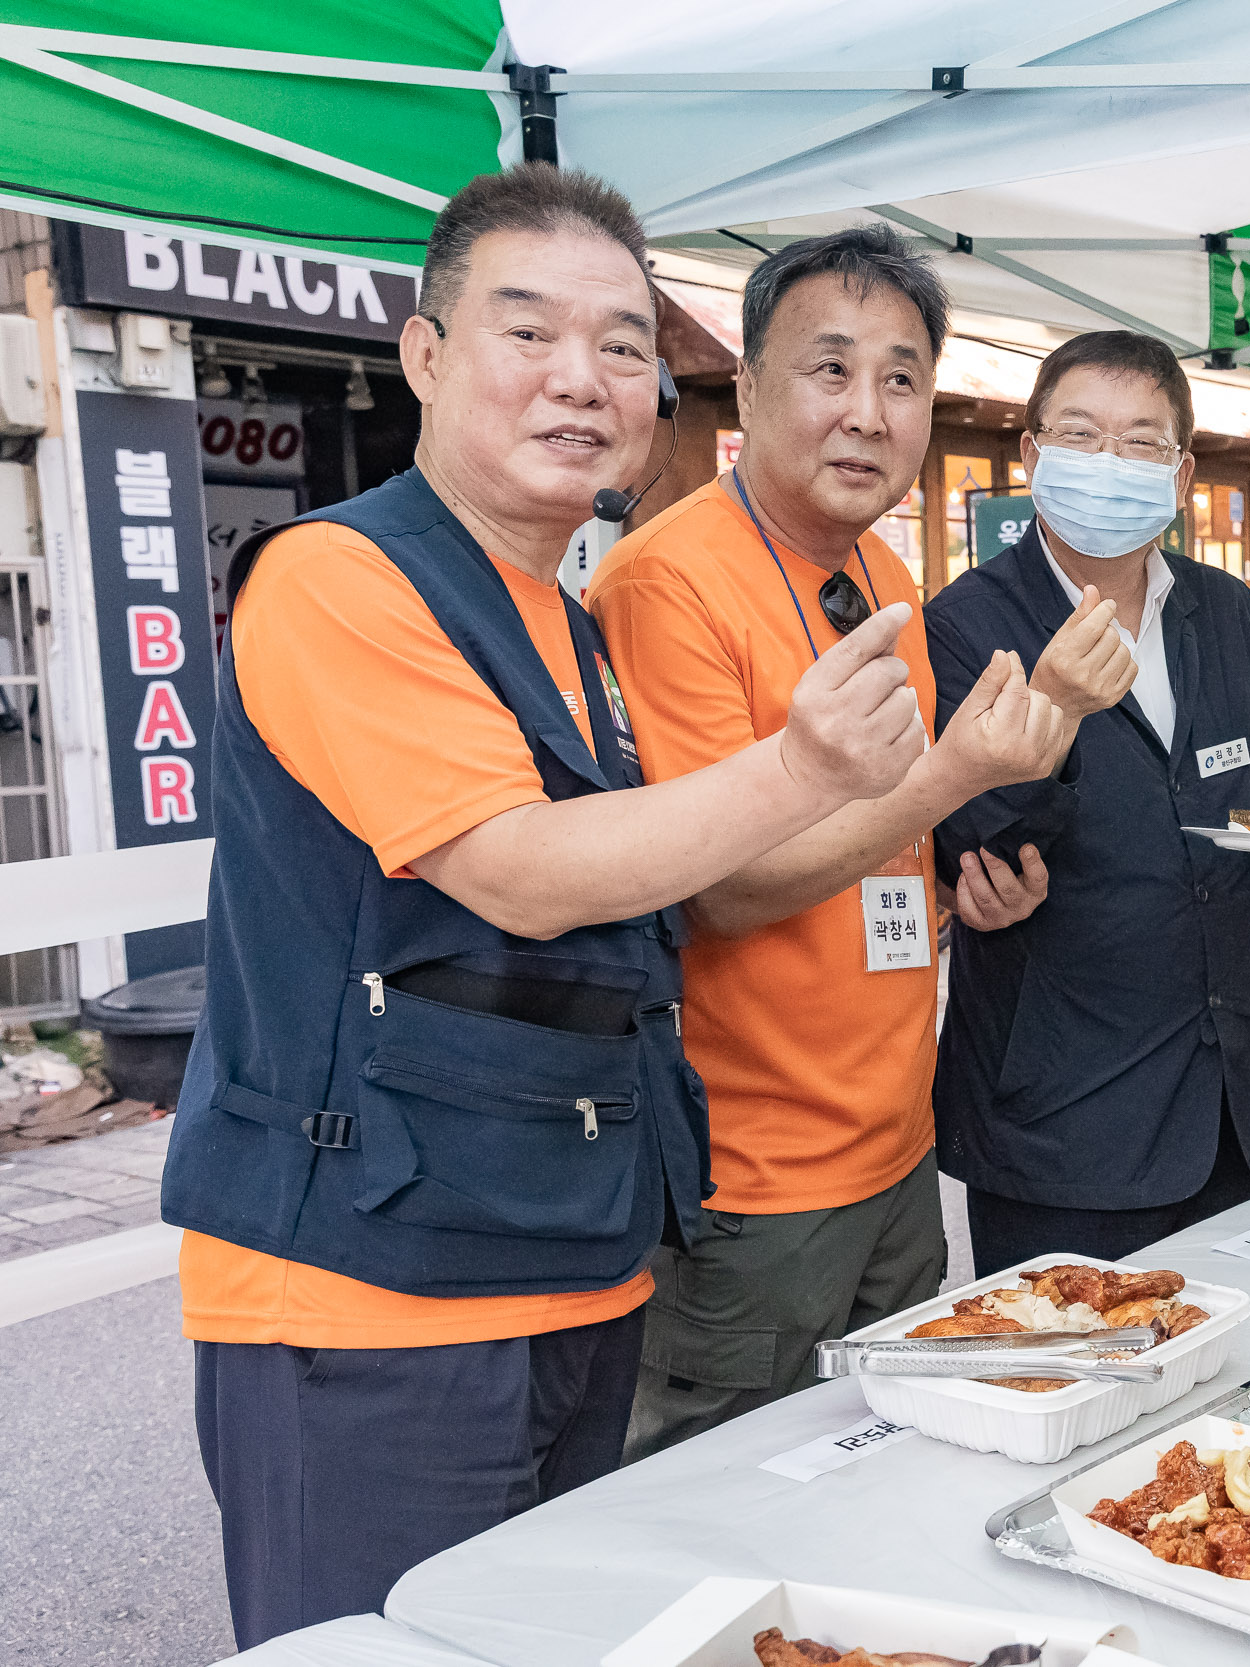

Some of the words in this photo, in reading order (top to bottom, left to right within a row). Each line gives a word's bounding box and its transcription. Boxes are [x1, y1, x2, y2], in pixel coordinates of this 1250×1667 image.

[124, 230, 388, 324] BLACK
[115, 448, 180, 593] 블랙
[126, 605, 198, 826] BAR
[875, 919, 917, 941] 곽창식
